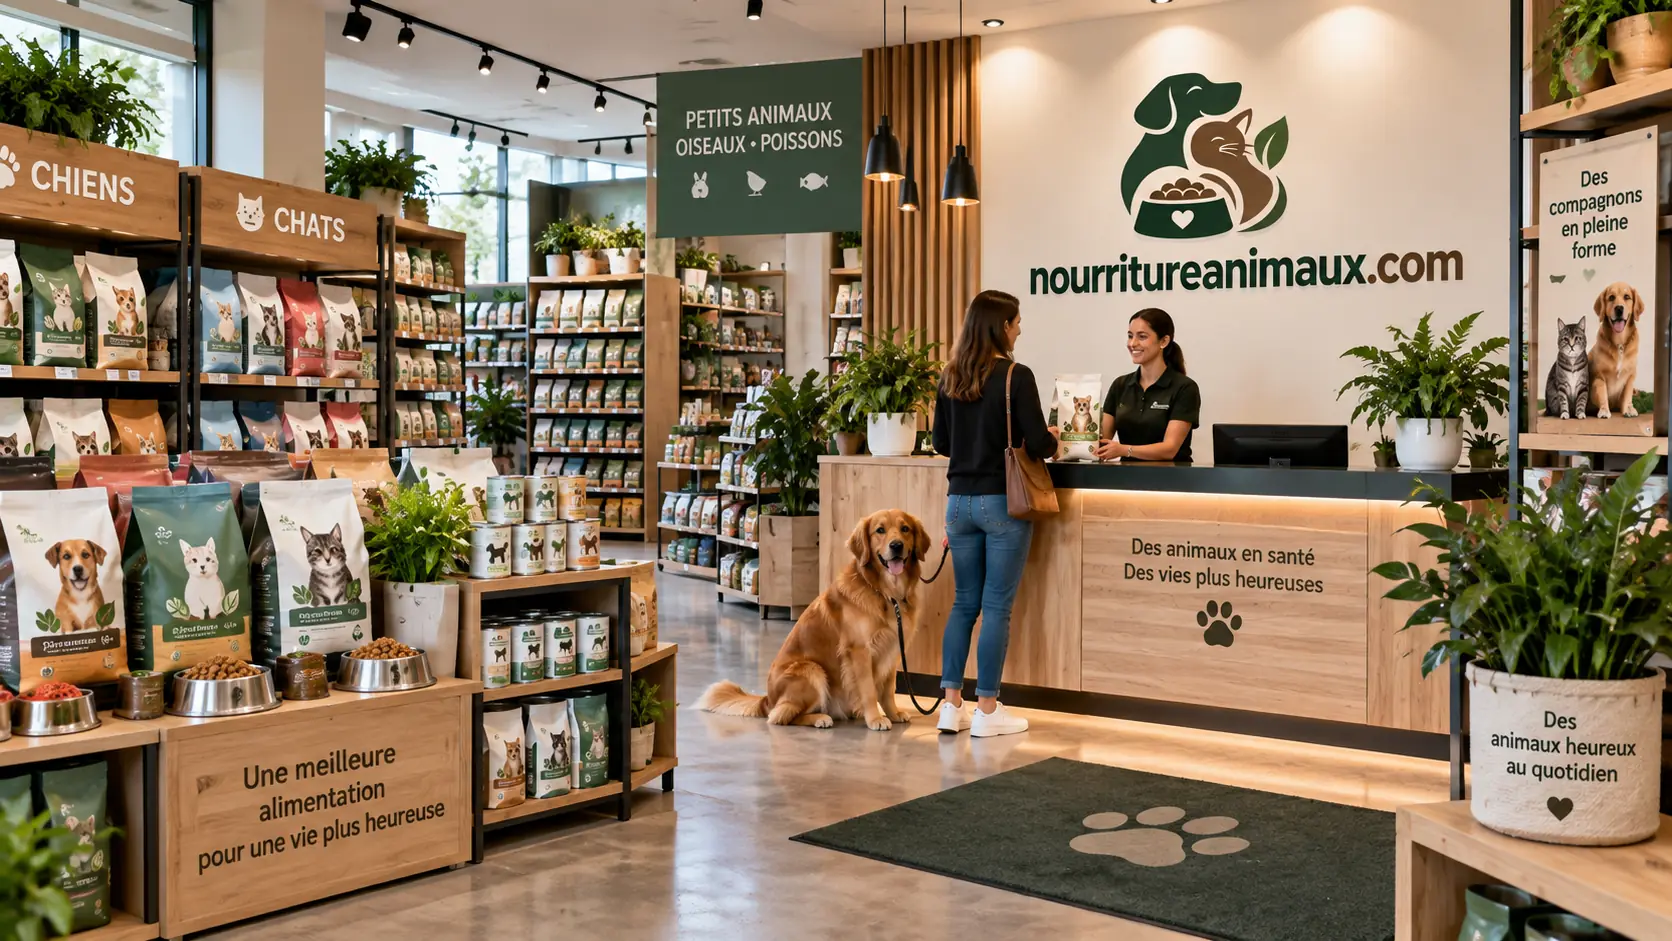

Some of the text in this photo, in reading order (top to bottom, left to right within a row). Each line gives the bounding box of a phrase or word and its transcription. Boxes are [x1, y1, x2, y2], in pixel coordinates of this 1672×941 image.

[687, 102, 831, 129] PETITS ANIMAUX
[676, 136, 745, 156] OISEAUX
[762, 130, 842, 151] POISSONS
[32, 161, 134, 205] CHIENS
[1582, 171, 1608, 187] Des
[1550, 190, 1642, 215] compagnons
[275, 208, 344, 242] CHATS
[1562, 215, 1628, 238] en pleine
[1572, 241, 1616, 258] forme
[1031, 247, 1463, 294] nourritureanimaux.com
[1133, 538, 1314, 565] Des animaux en santé
[1125, 563, 1323, 593] Des vies plus heureuses
[1545, 711, 1576, 729] Des
[1492, 732, 1636, 756] animaux heureux
[244, 747, 396, 789] Une meilleure
[1507, 762, 1617, 782] au quotidien
[260, 783, 386, 822] alimentation
[199, 803, 444, 875] pour une vie plus heureuse
